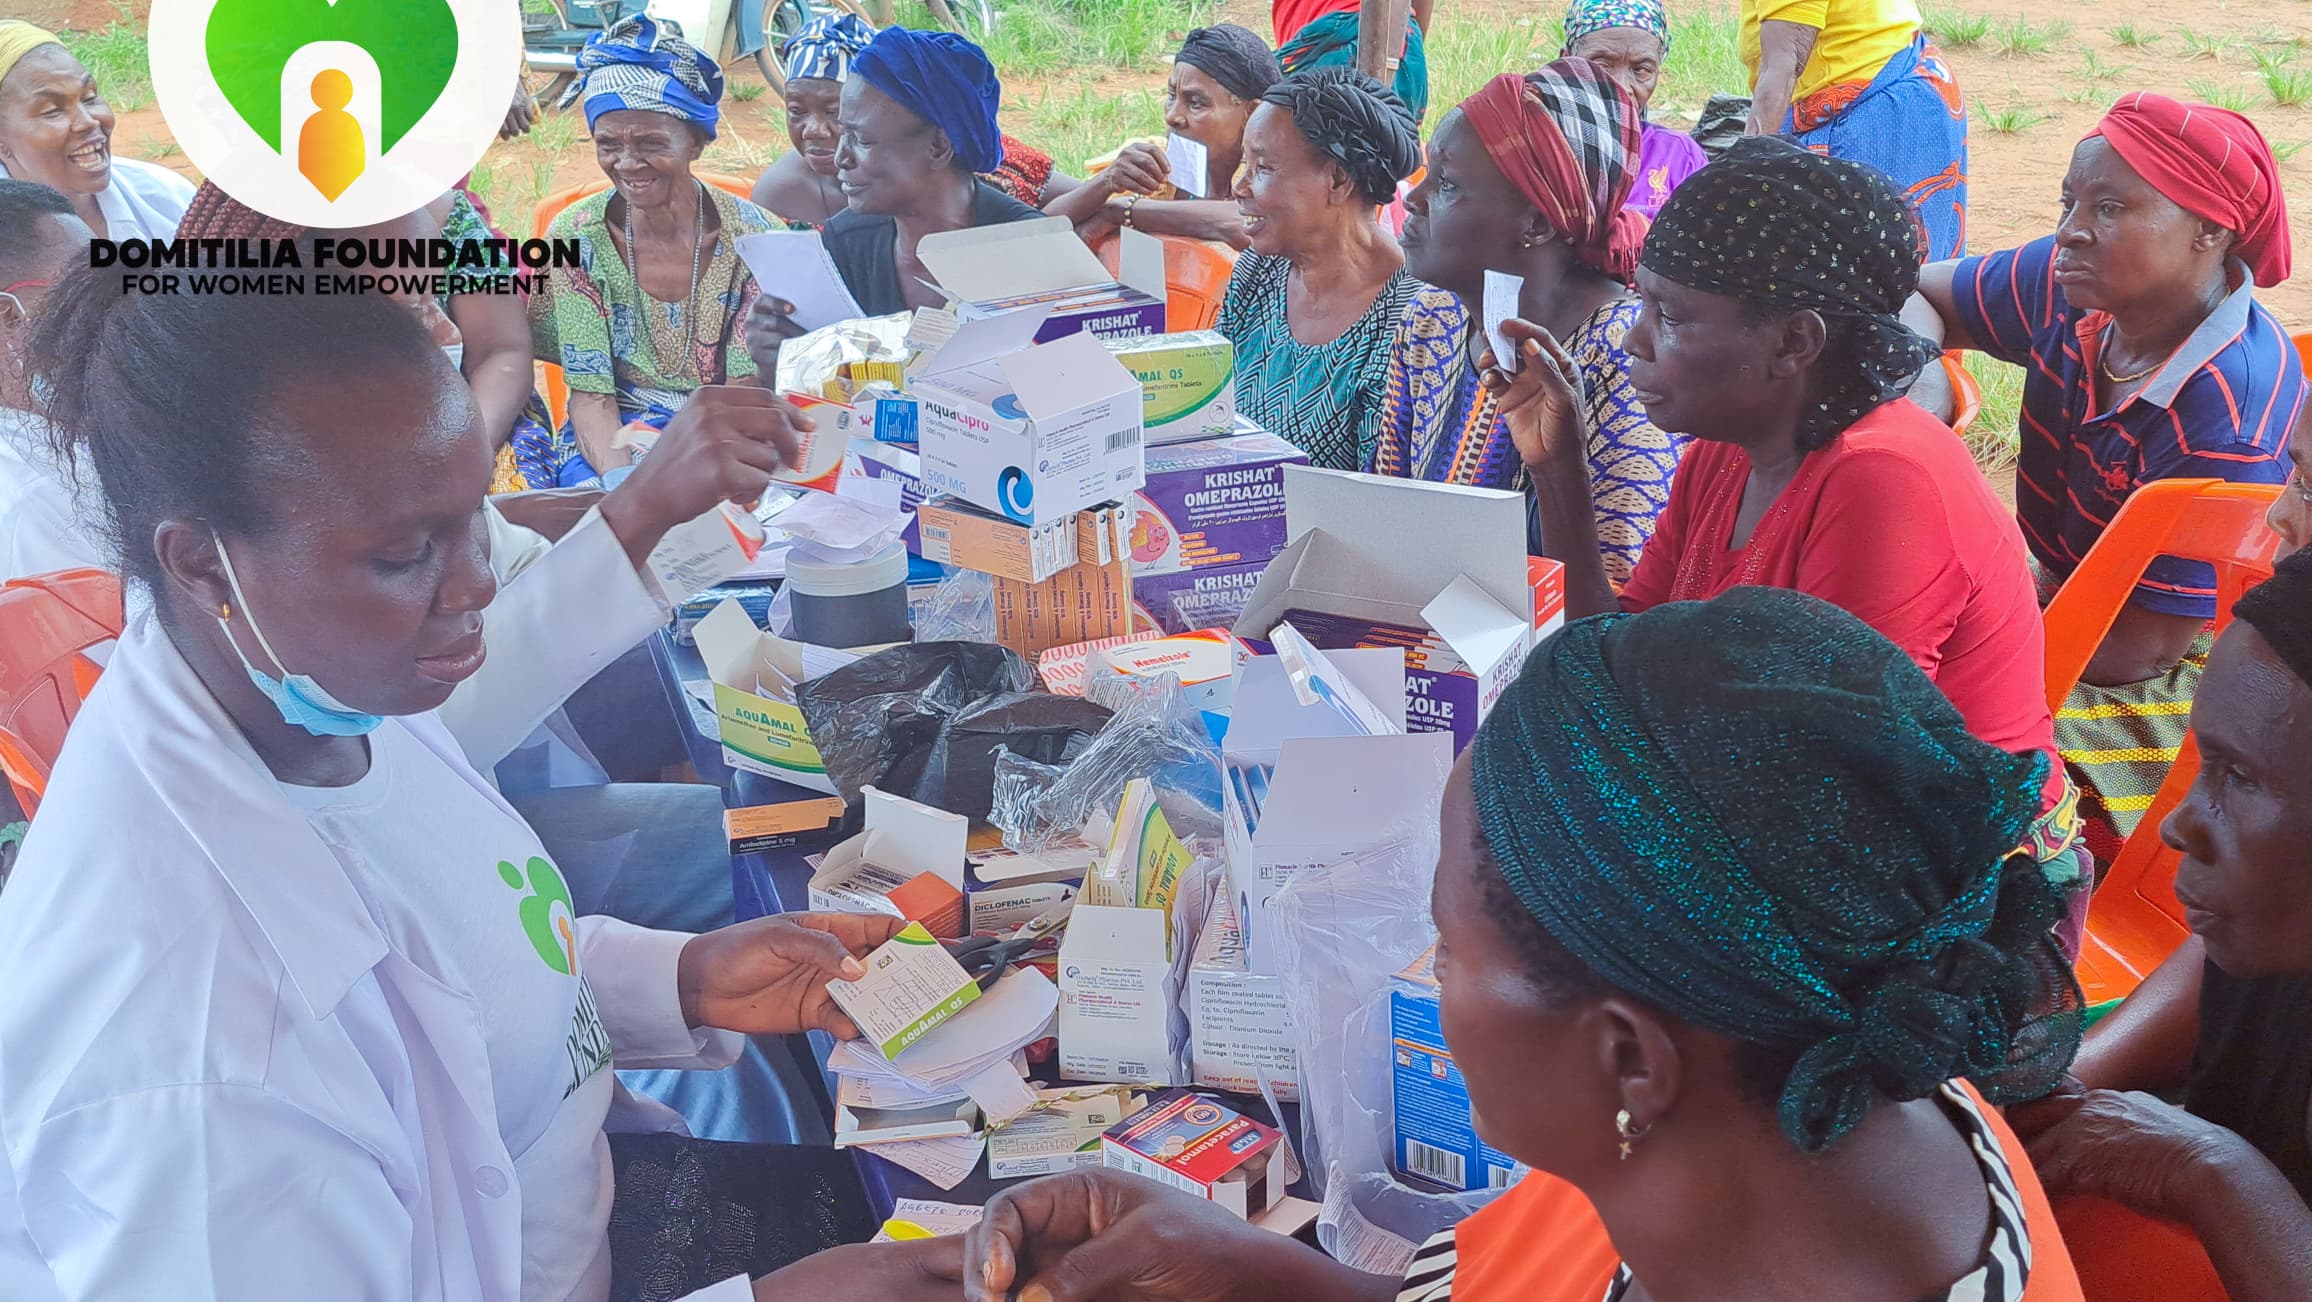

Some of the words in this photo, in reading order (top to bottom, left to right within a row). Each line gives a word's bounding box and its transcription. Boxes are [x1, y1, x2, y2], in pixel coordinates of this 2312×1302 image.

[1081, 313, 1139, 331] KRISHAT
[1131, 369, 1162, 382] AMAL
[1169, 368, 1184, 380] QS
[927, 469, 946, 486] 500
[949, 476, 967, 494] MG
[1204, 467, 1275, 489] KRISHAT
[1184, 483, 1284, 507] OMEPRAZOL
[1194, 571, 1264, 593] KRISHAT
[1174, 589, 1254, 610] OMEPRAZ
[1492, 641, 1524, 687] KRISHAT
[1483, 648, 1529, 711] OMEPRAZO
[735, 707, 797, 734] AQUAMAL
[758, 727, 770, 735] and
[771, 730, 814, 746] Lumefantrin
[974, 897, 1032, 912] DICLOFENAC
[1217, 989, 1230, 997] film
[1243, 999, 1286, 1010] Hydrochlorid
[901, 1009, 948, 1046] AQUAMAL
[1203, 1048, 1228, 1058] Storage
[1233, 1060, 1256, 1068] Protec
[1242, 1076, 1257, 1084] reac
[1271, 1088, 1288, 1096] fully
[1176, 1119, 1249, 1166] Paracetamol
